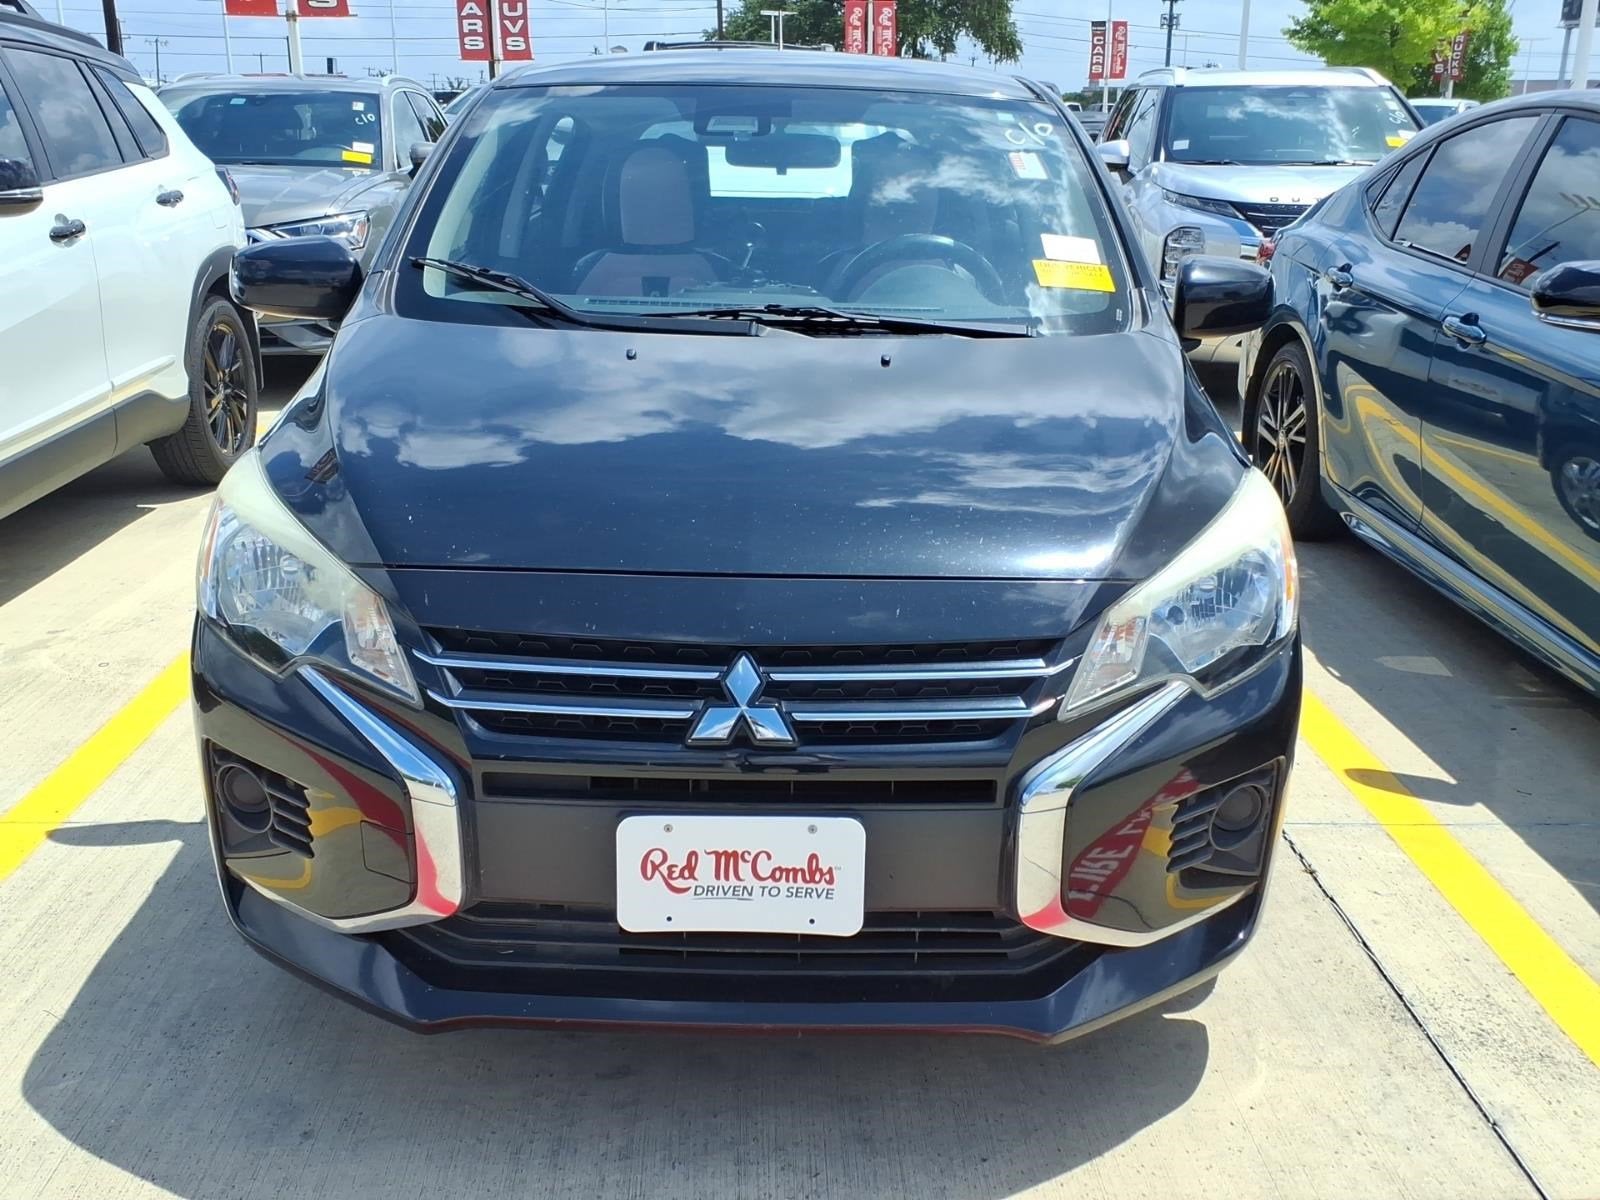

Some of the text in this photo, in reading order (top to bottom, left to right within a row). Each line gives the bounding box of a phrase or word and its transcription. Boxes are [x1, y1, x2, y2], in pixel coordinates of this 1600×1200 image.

[1091, 36, 1104, 73] CARS
[640, 847, 836, 894] Red McCombs
[693, 884, 836, 901] DRIVEN TO SERVE
